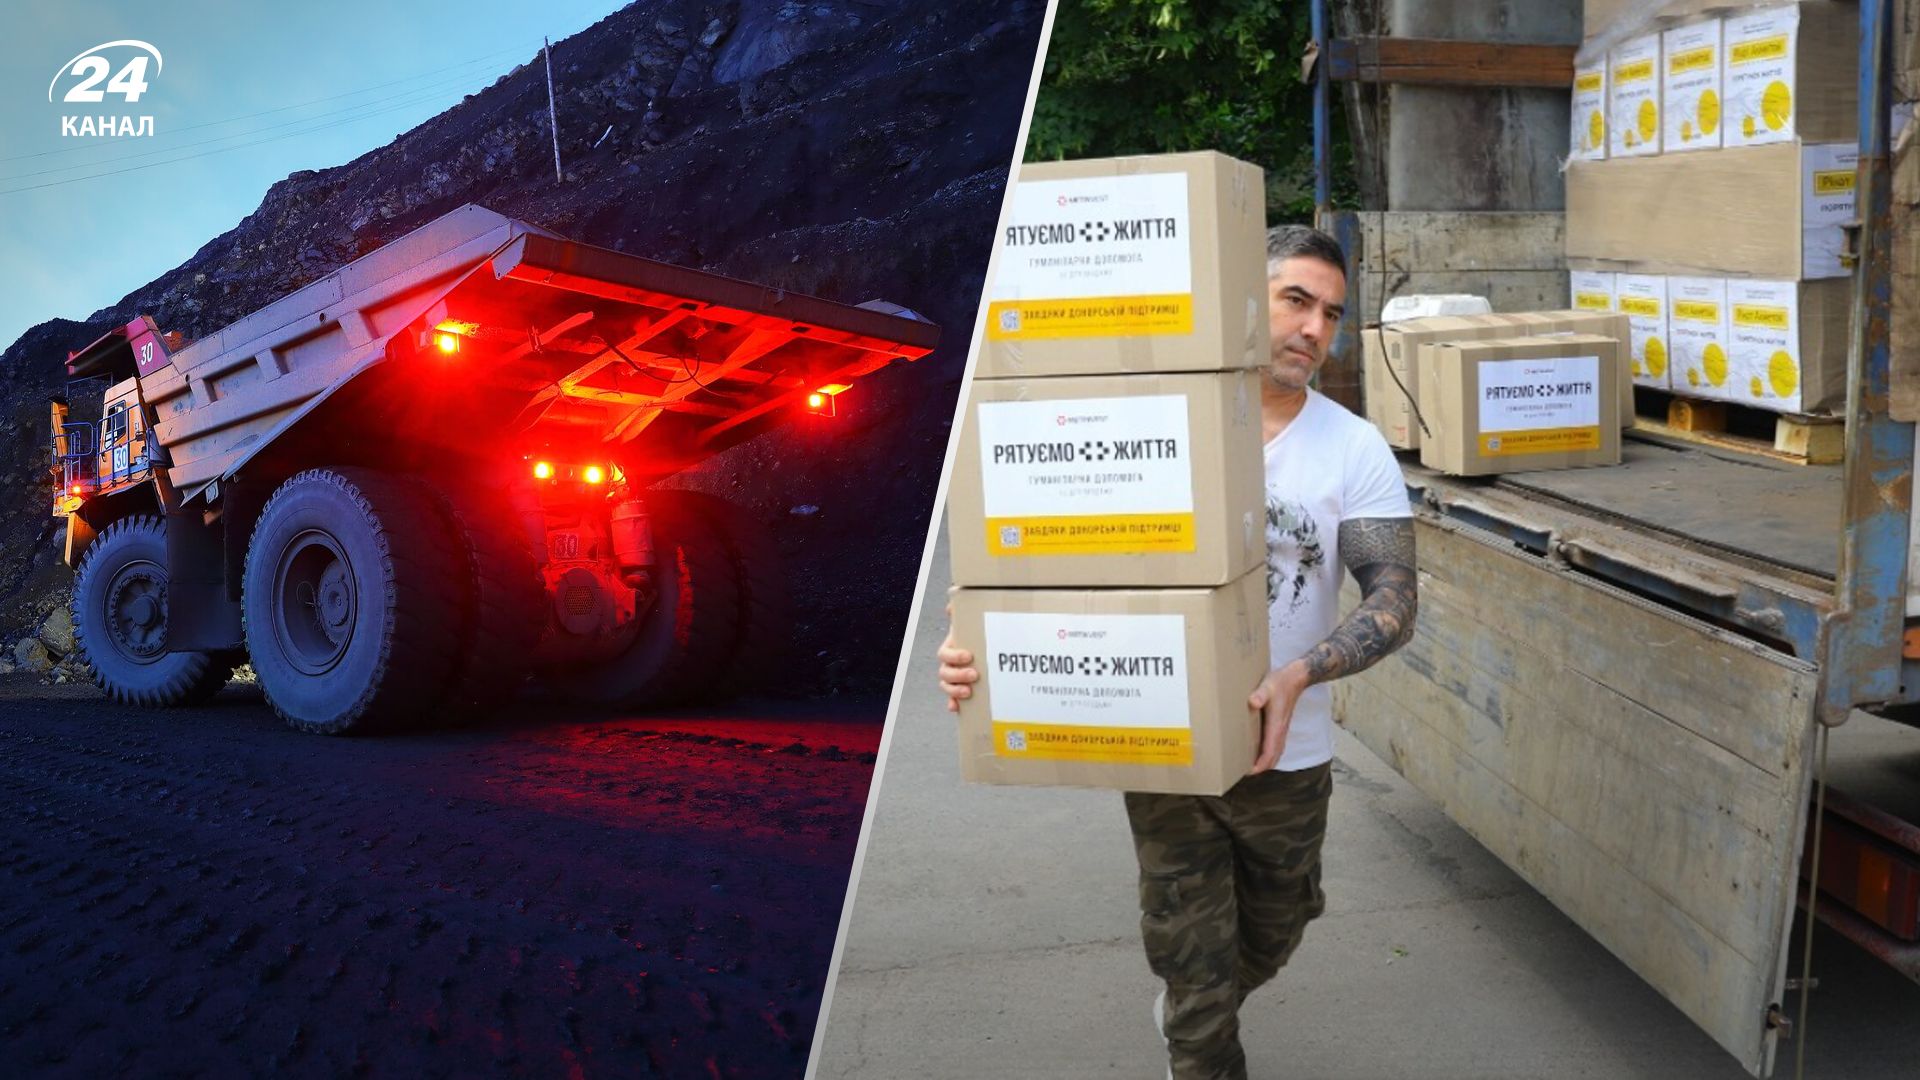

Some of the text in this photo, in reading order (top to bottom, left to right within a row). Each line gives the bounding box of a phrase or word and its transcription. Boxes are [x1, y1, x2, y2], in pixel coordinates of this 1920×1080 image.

[1005, 217, 1176, 247] ЯТУЄМО ЖИТТЯ
[141, 342, 153, 366] 30
[1556, 381, 1592, 396] ЖИТТЯ
[116, 448, 127, 469] 30
[994, 438, 1177, 464] РЯТУЄМО ЖИТТЯ
[999, 653, 1174, 677] РЯТУЄМО ЖИТТЯ
